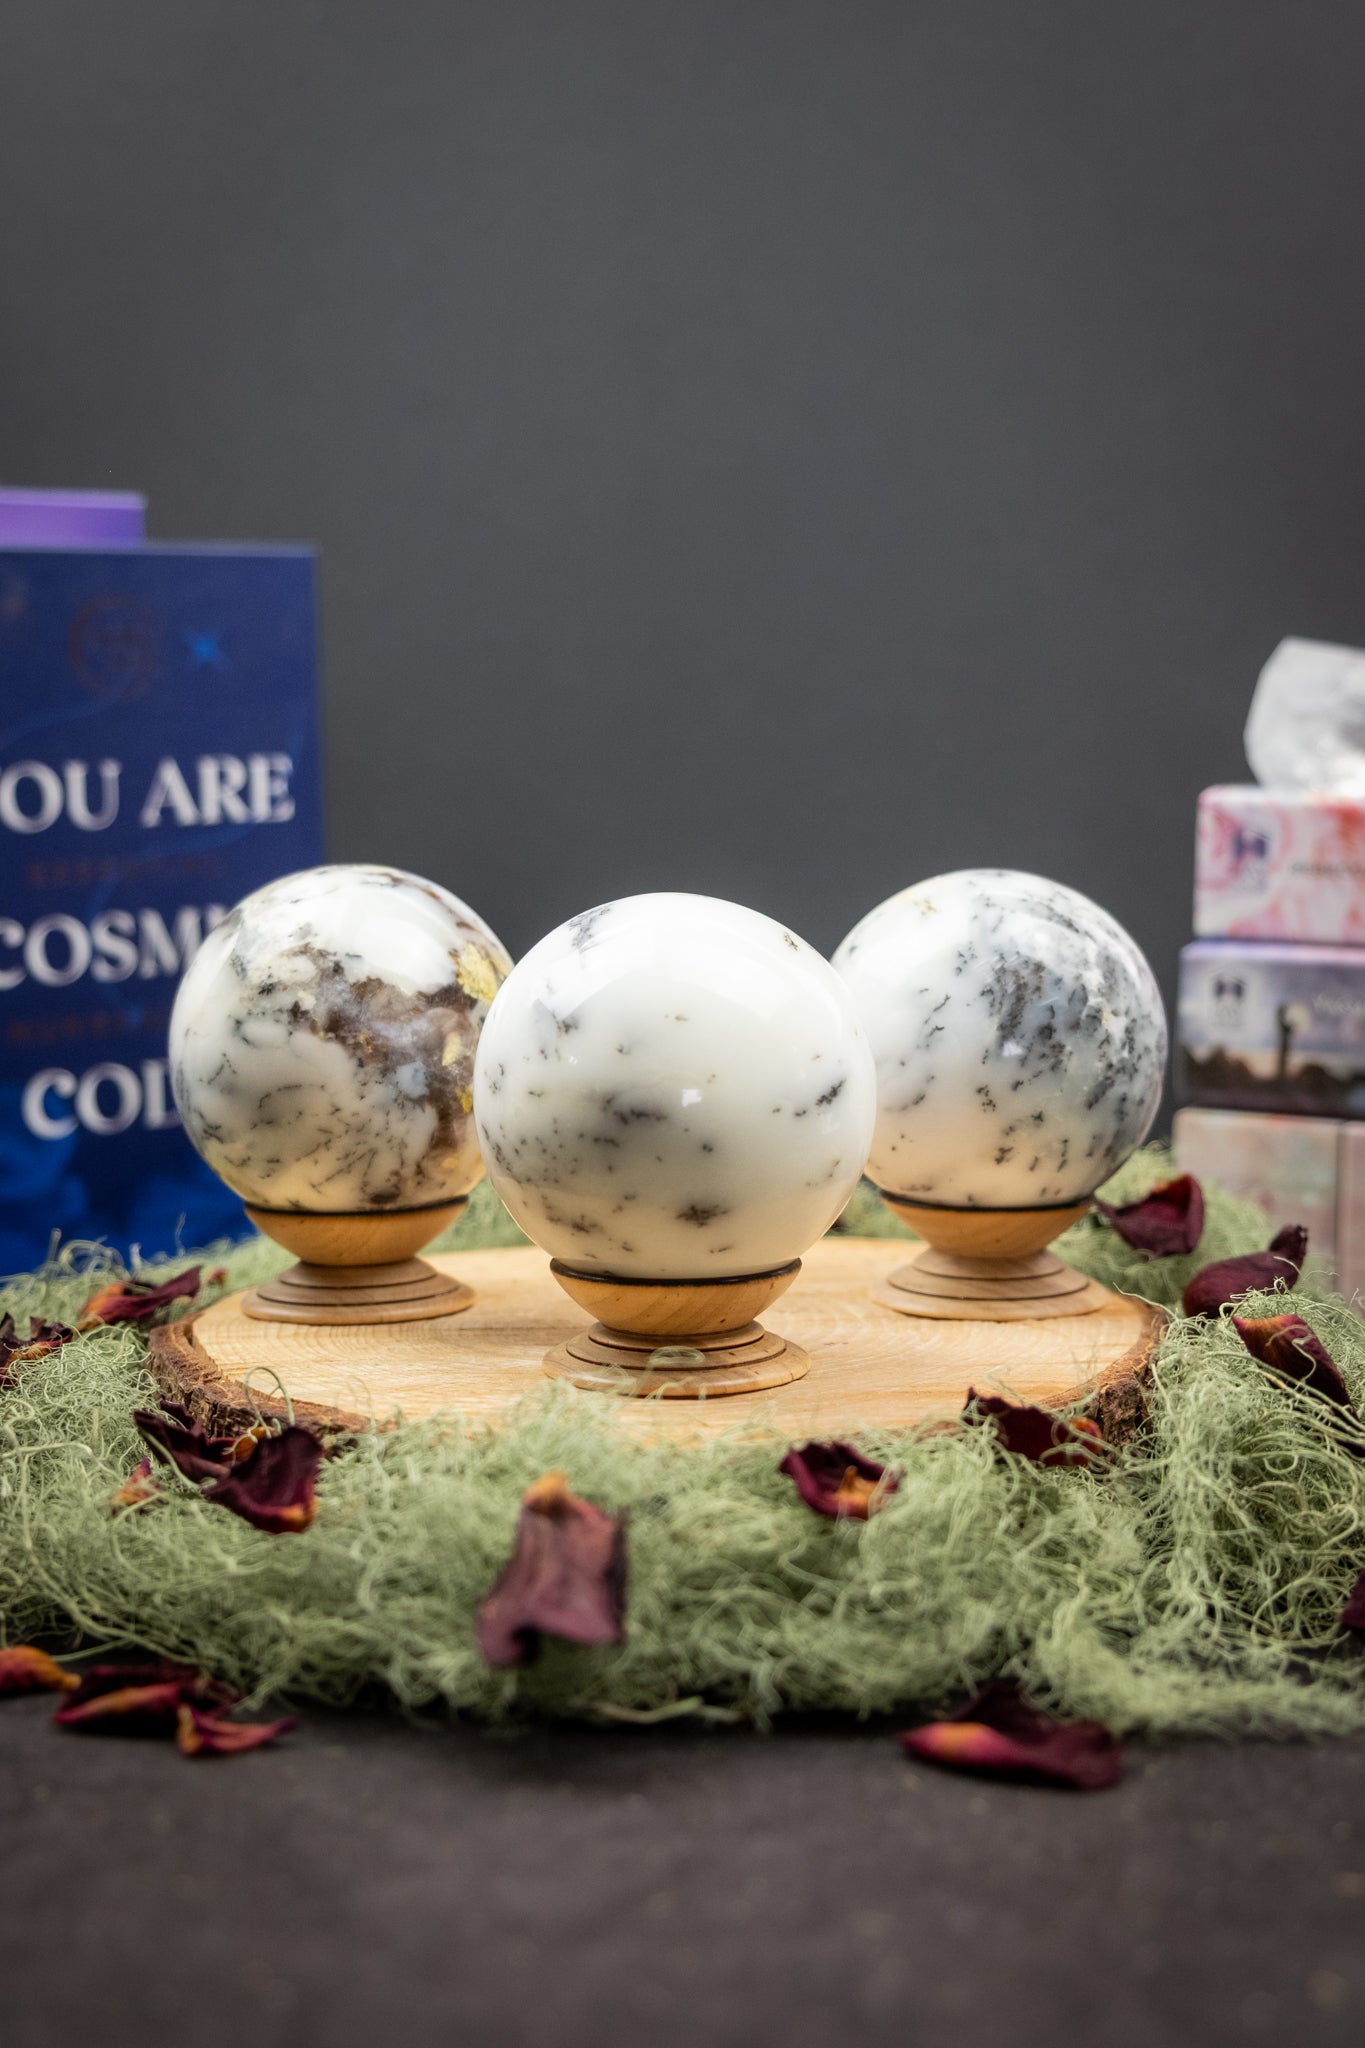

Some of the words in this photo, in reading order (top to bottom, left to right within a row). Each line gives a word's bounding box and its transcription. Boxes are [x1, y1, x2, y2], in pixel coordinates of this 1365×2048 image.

[0, 759, 121, 834] OU
[140, 753, 296, 828] ARE
[0, 904, 227, 991] COSM
